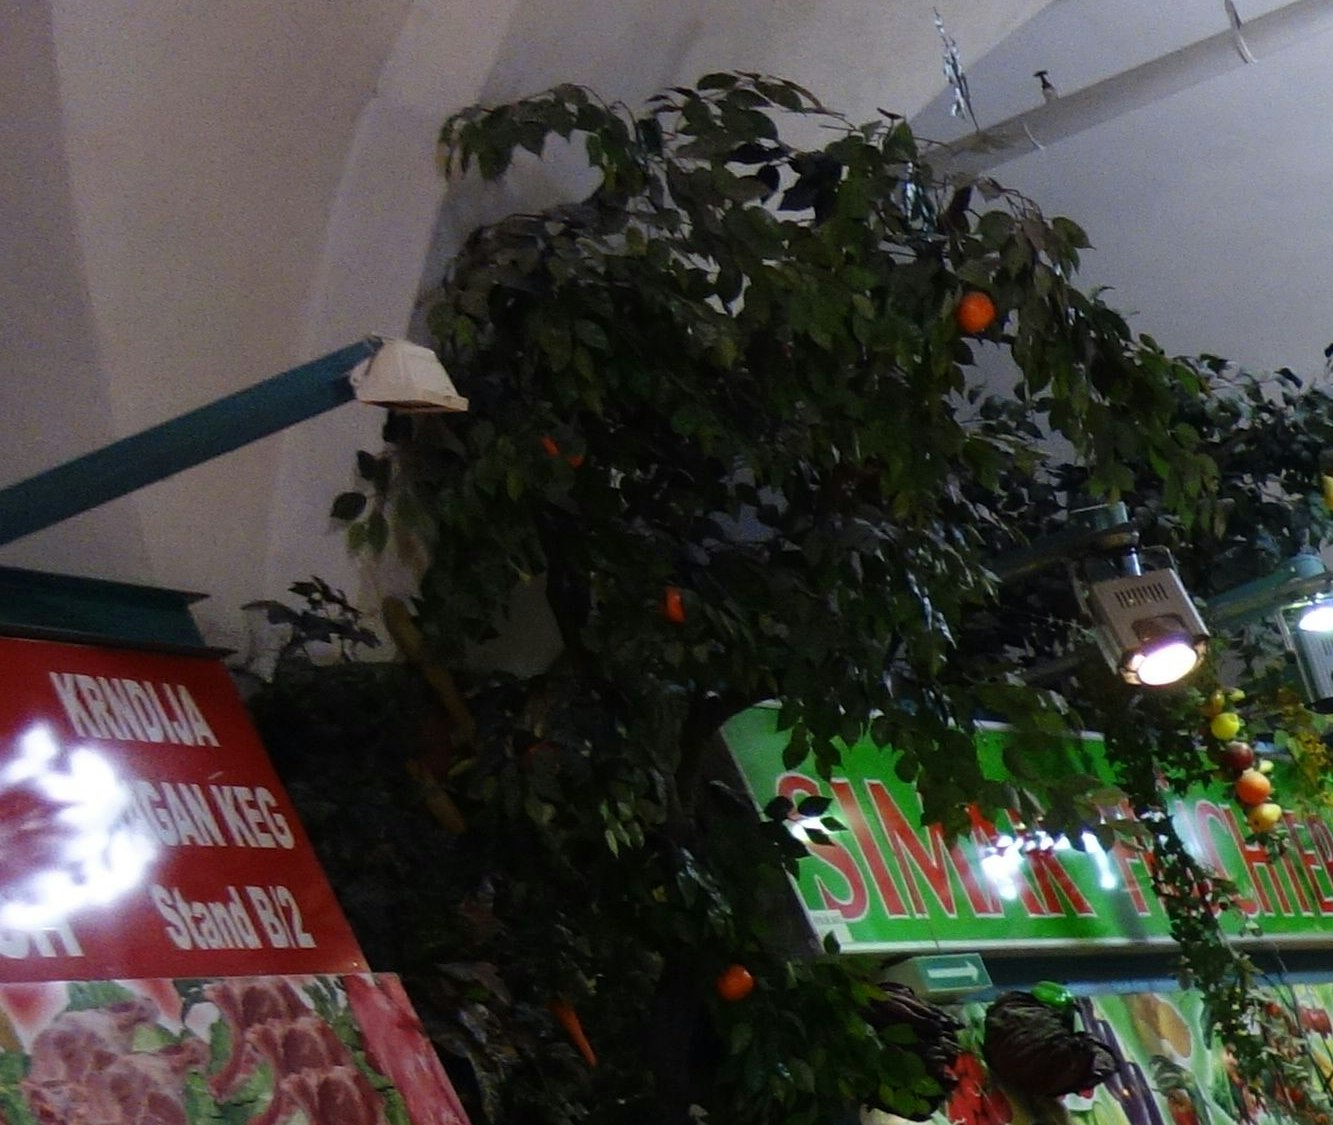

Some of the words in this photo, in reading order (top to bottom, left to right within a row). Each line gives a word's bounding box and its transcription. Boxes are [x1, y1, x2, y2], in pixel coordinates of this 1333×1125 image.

[50, 671, 221, 748] KRNDIJA
[208, 784, 295, 850] KEG
[149, 884, 263, 951] Stand
[245, 885, 317, 949] B/2
